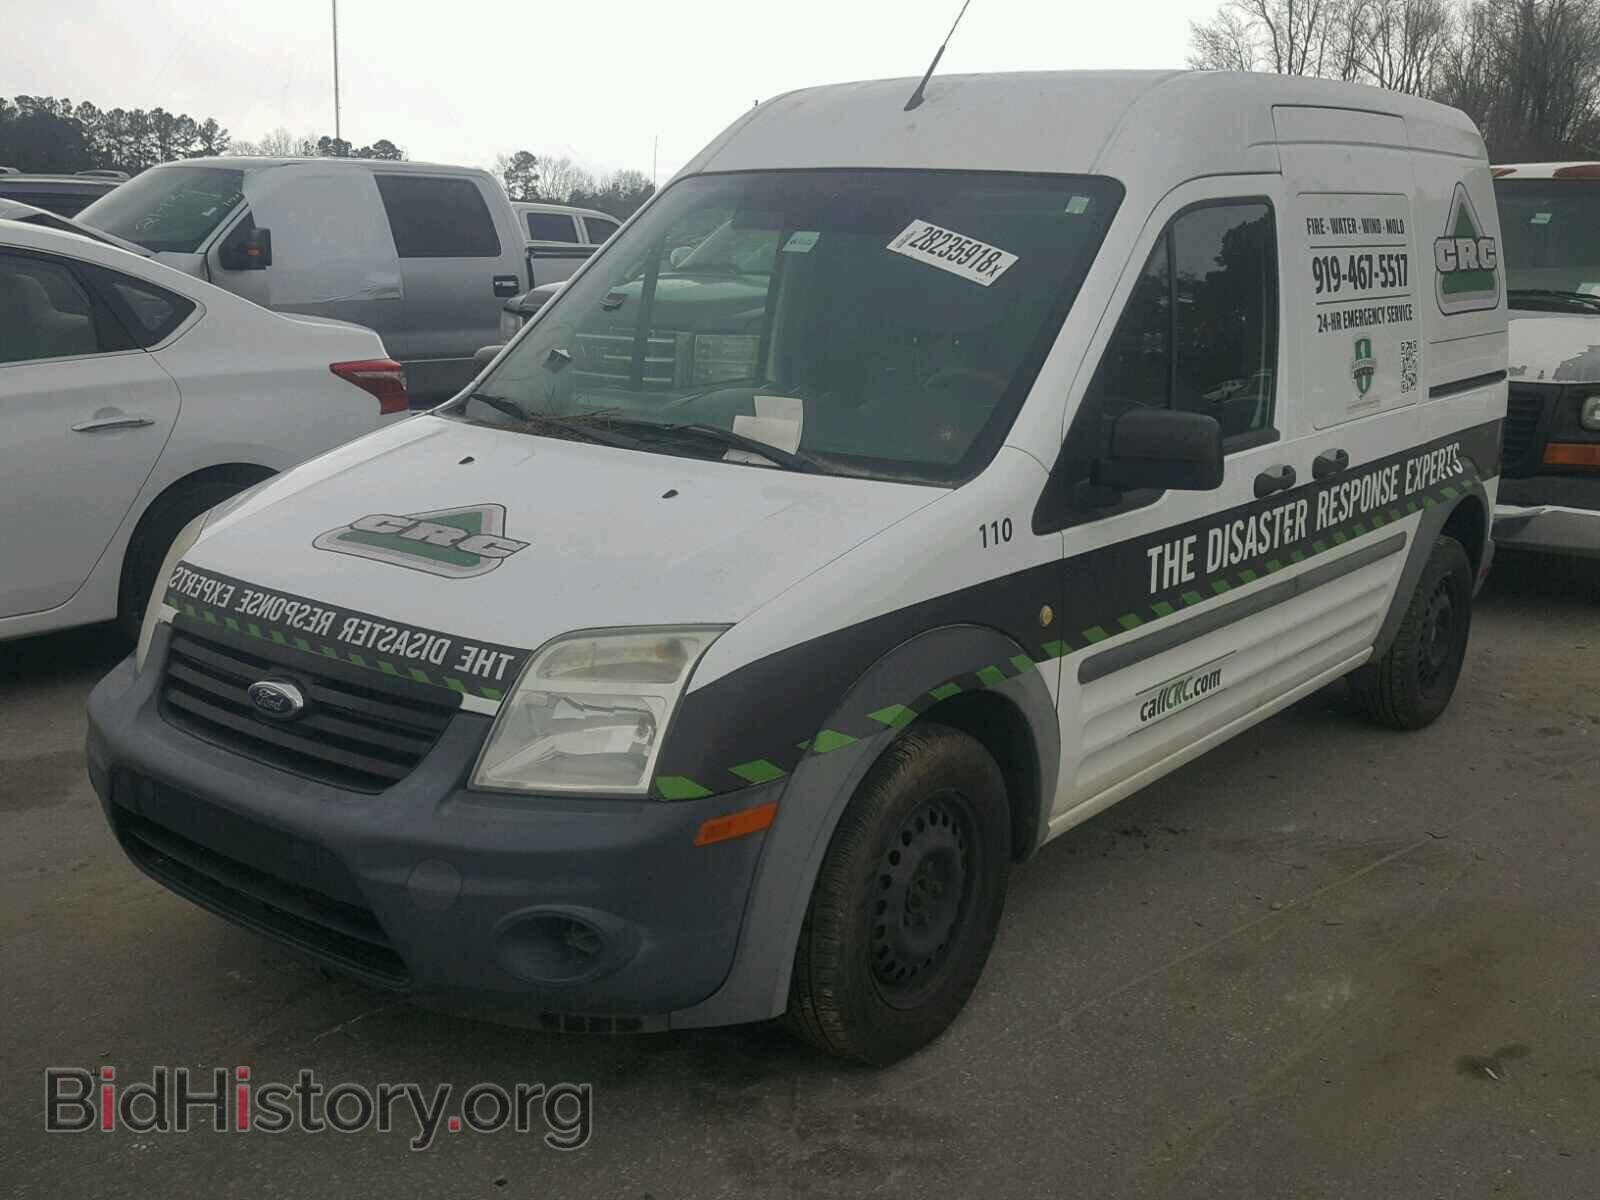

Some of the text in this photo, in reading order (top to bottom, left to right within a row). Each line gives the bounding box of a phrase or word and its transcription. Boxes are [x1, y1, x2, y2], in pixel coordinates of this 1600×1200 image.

[1306, 218, 1405, 235] FIRE WATER WIND MOLD
[1433, 237, 1498, 272] CRC
[1312, 254, 1408, 294] 919-467-5517
[1317, 304, 1413, 333] 24-HR EMERGENCY SERVICE
[350, 513, 531, 558] CRC
[979, 518, 1013, 549] 110
[1147, 442, 1463, 594] THE DISASTER RESPONSE EXPERTS
[1140, 668, 1221, 722] callCRC.com
